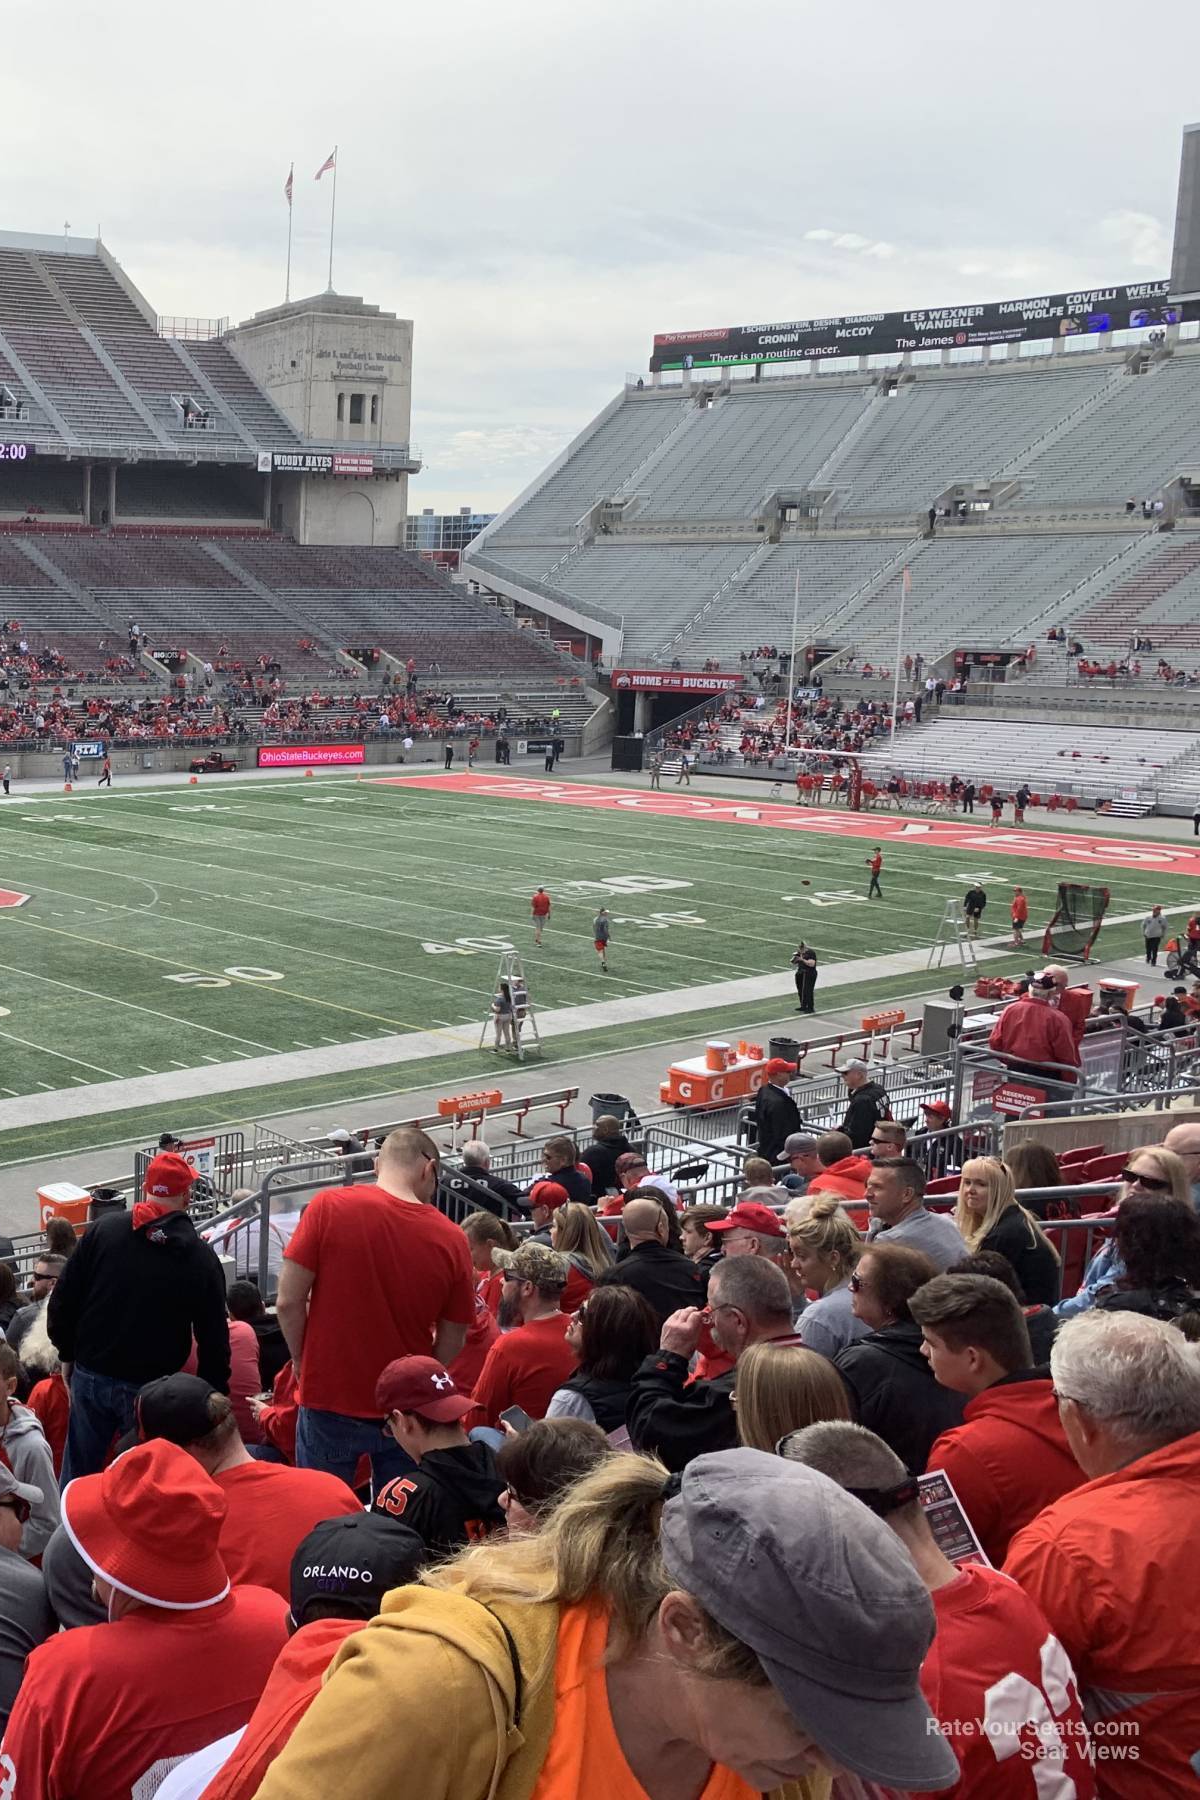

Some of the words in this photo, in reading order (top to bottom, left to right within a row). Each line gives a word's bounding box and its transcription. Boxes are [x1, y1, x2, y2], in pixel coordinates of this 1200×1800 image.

[1066, 289, 1117, 305] COVELLI
[1126, 282, 1170, 297] WELLS
[999, 298, 1050, 314] HARMON
[1022, 307, 1064, 321] WOLFE
[1067, 303, 1093, 315] FDN
[813, 318, 842, 328] DESHE,
[845, 313, 885, 324] DIAMOND
[903, 313, 927, 323] LES
[928, 306, 985, 321] WEXNER
[914, 317, 974, 331] WANDELL
[664, 334, 677, 342] Pay
[677, 332, 700, 341] Forward
[701, 329, 727, 339] Society
[758, 333, 799, 346] CRONIN
[835, 326, 875, 339] McCOY
[895, 338, 917, 349] The
[918, 335, 954, 348] James
[709, 353, 739, 364] There
[740, 352, 749, 361] is
[750, 352, 764, 361] no
[766, 348, 803, 359] routine
[803, 345, 841, 356] cancer.
[364, 363, 384, 371] Center
[274, 454, 304, 467] WOODY
[305, 455, 333, 467] HAYES
[632, 675, 662, 686] HOME
[682, 678, 736, 689] BUCKEYES
[260, 750, 364, 763] OhioStateBuckeyes.com
[470, 783, 1198, 863] BUCKEYES
[611, 911, 707, 929] 30
[421, 936, 515, 955] 40
[162, 966, 285, 989] 50
[679, 1082, 693, 1098] G
[711, 1078, 725, 1100] G
[1002, 1090, 1036, 1102] RESERVED
[458, 1097, 491, 1109] GATORADE
[995, 1095, 1013, 1104] CLUB
[377, 1476, 419, 1516] 15
[302, 1564, 373, 1583] ORLANDO
[316, 1578, 347, 1592] CITY
